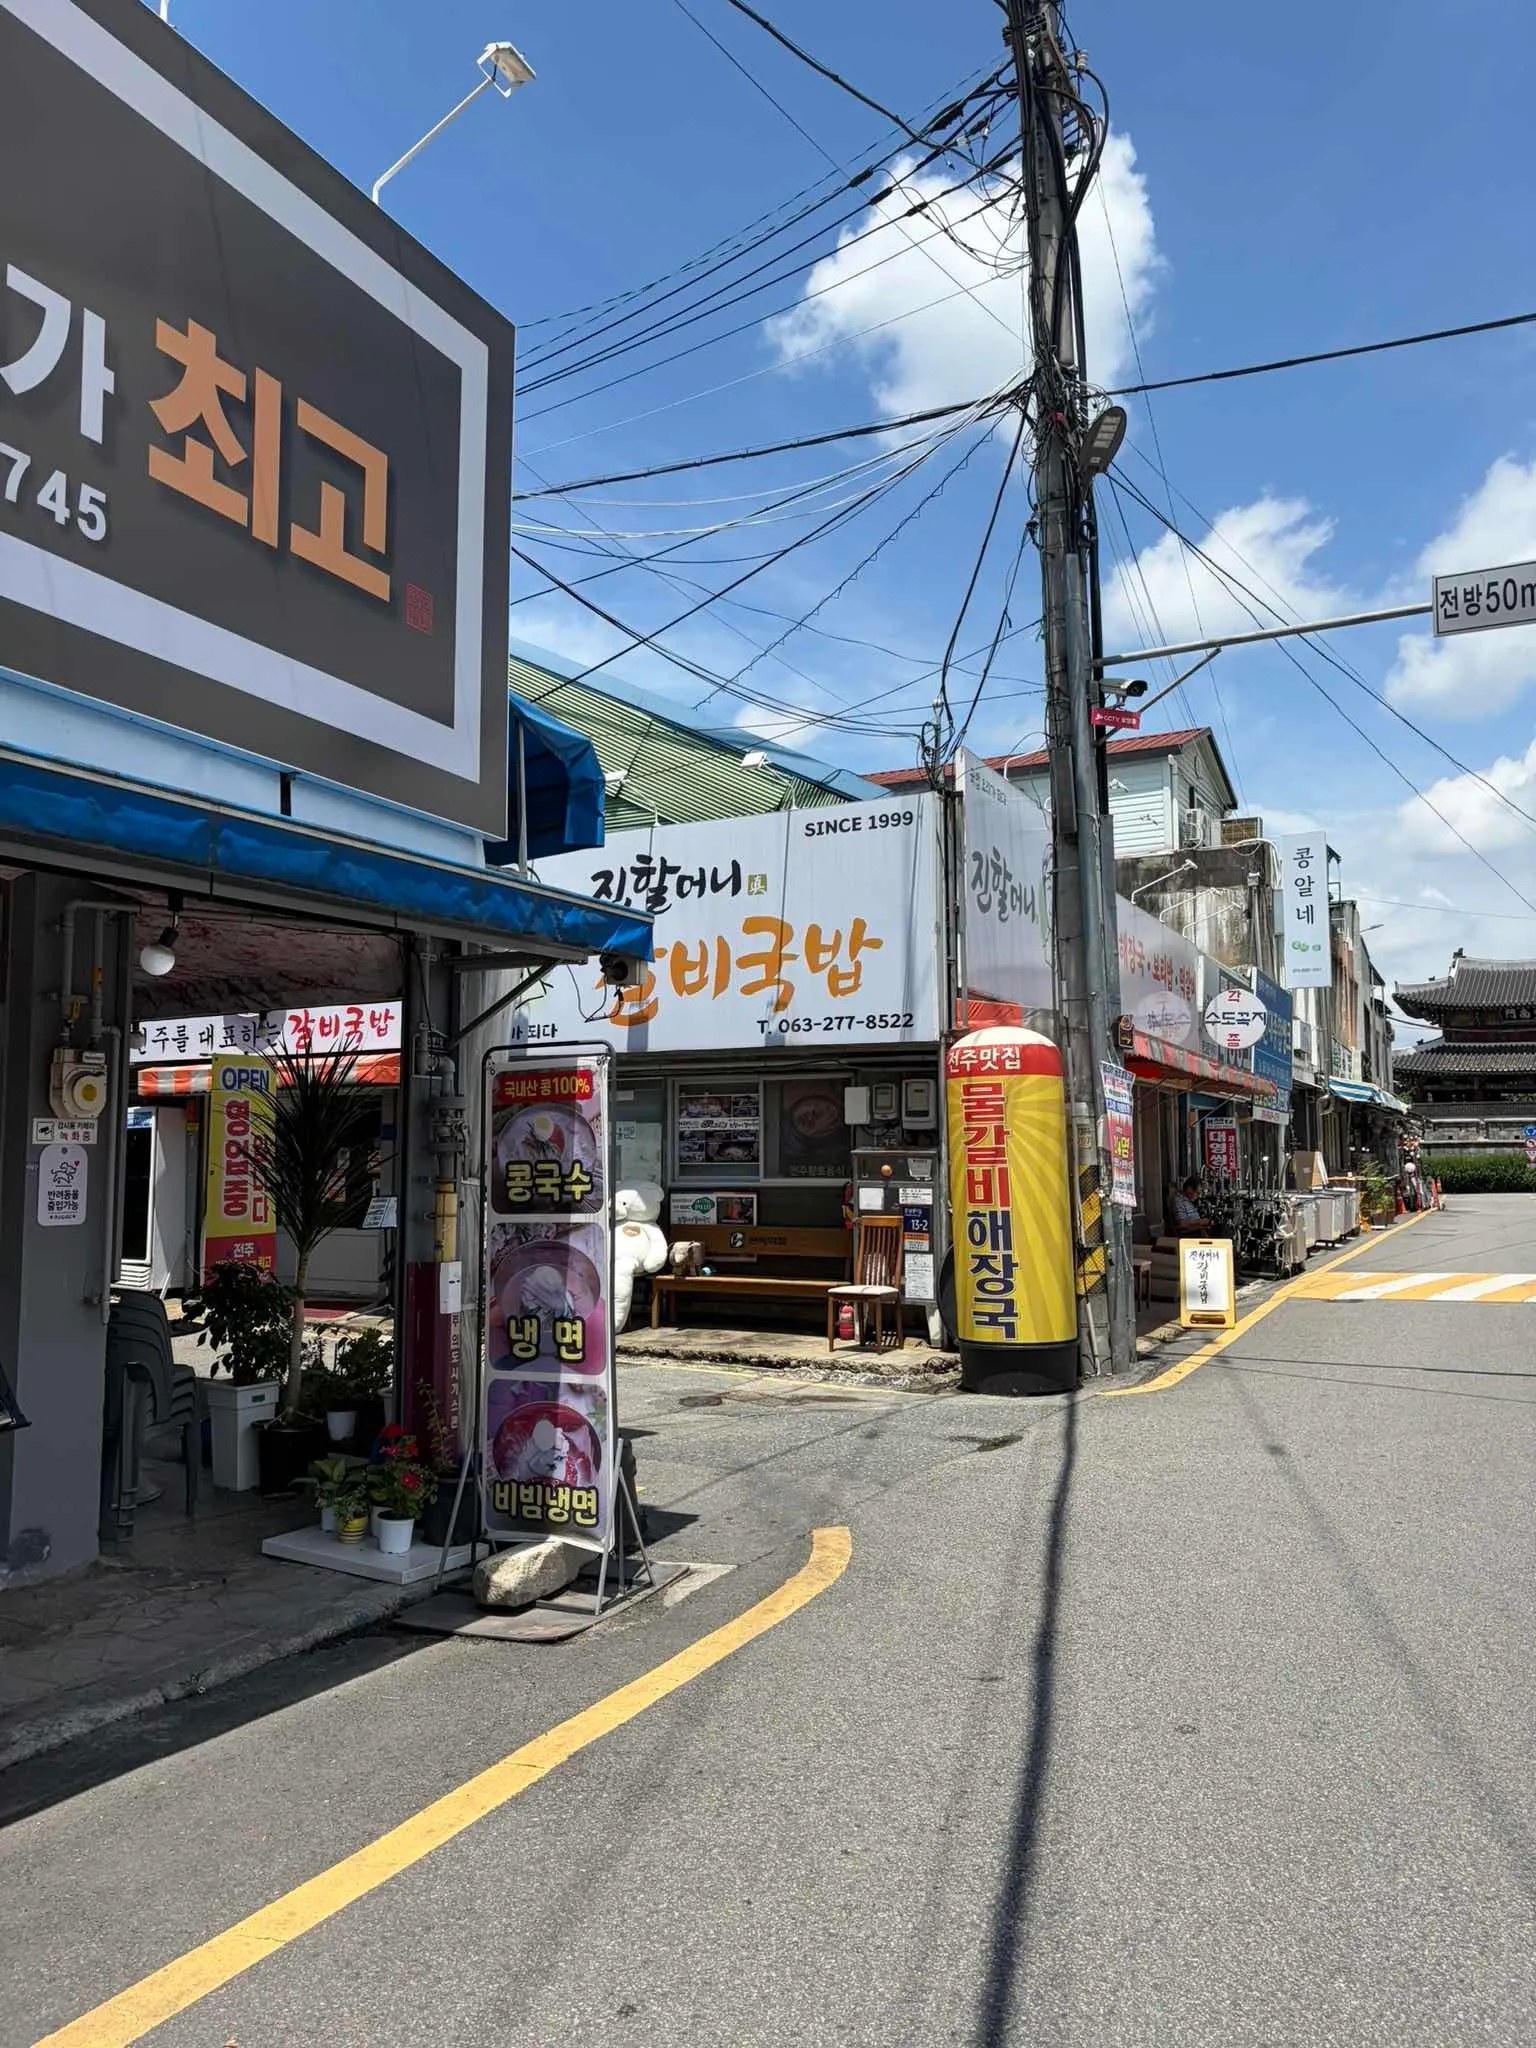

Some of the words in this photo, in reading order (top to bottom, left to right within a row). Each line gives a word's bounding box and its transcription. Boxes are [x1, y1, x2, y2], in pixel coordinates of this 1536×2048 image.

[148, 316, 391, 603] 최고
[804, 816, 863, 838] SINCE
[868, 811, 914, 831] 1999
[591, 854, 742, 915] 진할머니
[970, 846, 1036, 925] 진할머니
[1292, 847, 1315, 925] 콩알네
[287, 1006, 396, 1050] 갈비국밥
[757, 1019, 773, 1036] T.
[777, 1013, 914, 1034] 063-277-8522
[1205, 1011, 1267, 1027] 수도꼭지
[947, 1046, 1021, 1073] 전주맛집
[222, 1067, 270, 1091] OPEN
[504, 1077, 538, 1099] 국내산
[223, 1100, 250, 1218] 영업중
[506, 1160, 593, 1203] 콩국수
[47, 1190, 79, 1201] 반려동물
[911, 1219, 929, 1231] 13-2
[232, 1241, 255, 1258] 전주
[494, 1481, 599, 1526] 비빔냉면
